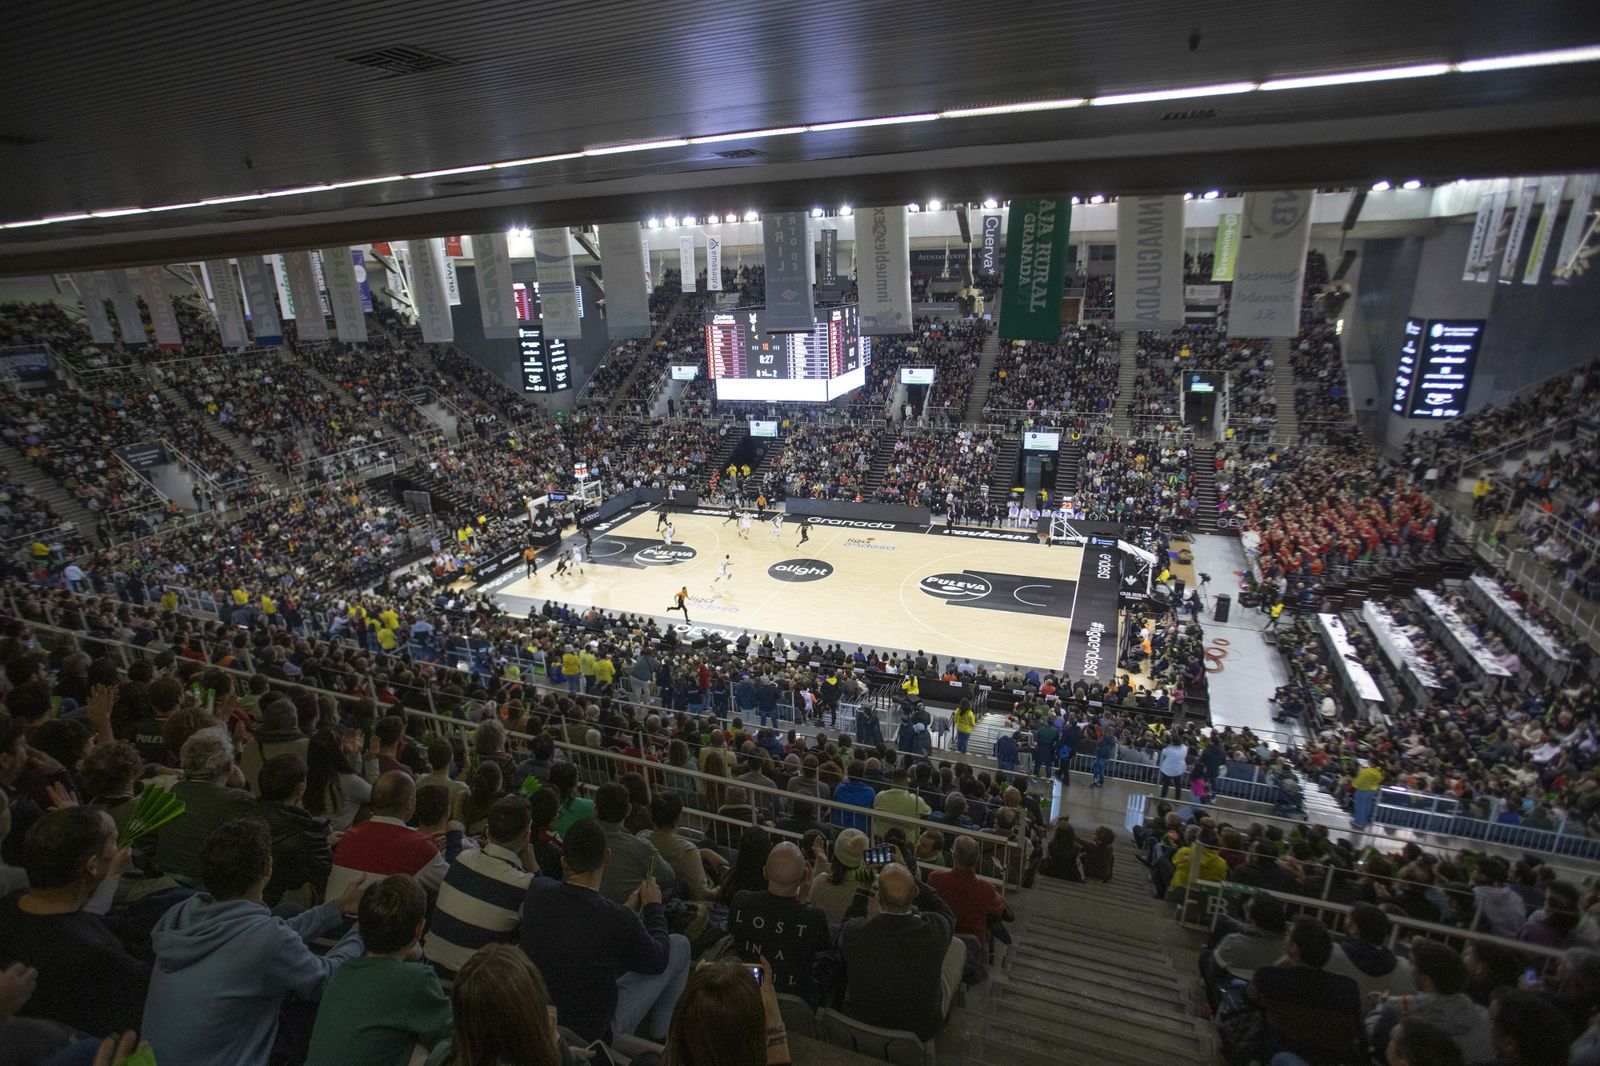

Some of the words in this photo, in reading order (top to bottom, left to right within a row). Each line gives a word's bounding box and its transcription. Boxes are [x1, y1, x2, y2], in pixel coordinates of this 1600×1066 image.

[1018, 214, 1036, 286] GRANADA
[446, 261, 456, 293] OLIVA
[711, 250, 719, 290] emasagra
[1029, 242, 1053, 313] RURAL
[807, 516, 896, 530] Granada
[643, 548, 694, 558] PULEVA
[843, 541, 896, 551] endesa
[775, 562, 828, 577] alight
[1097, 553, 1112, 579] endesa
[926, 575, 986, 592] PULEVA
[1083, 621, 1107, 677] #ligaendesa
[735, 909, 807, 937] LOST
[745, 940, 762, 955] IN
[774, 949, 785, 961] A
